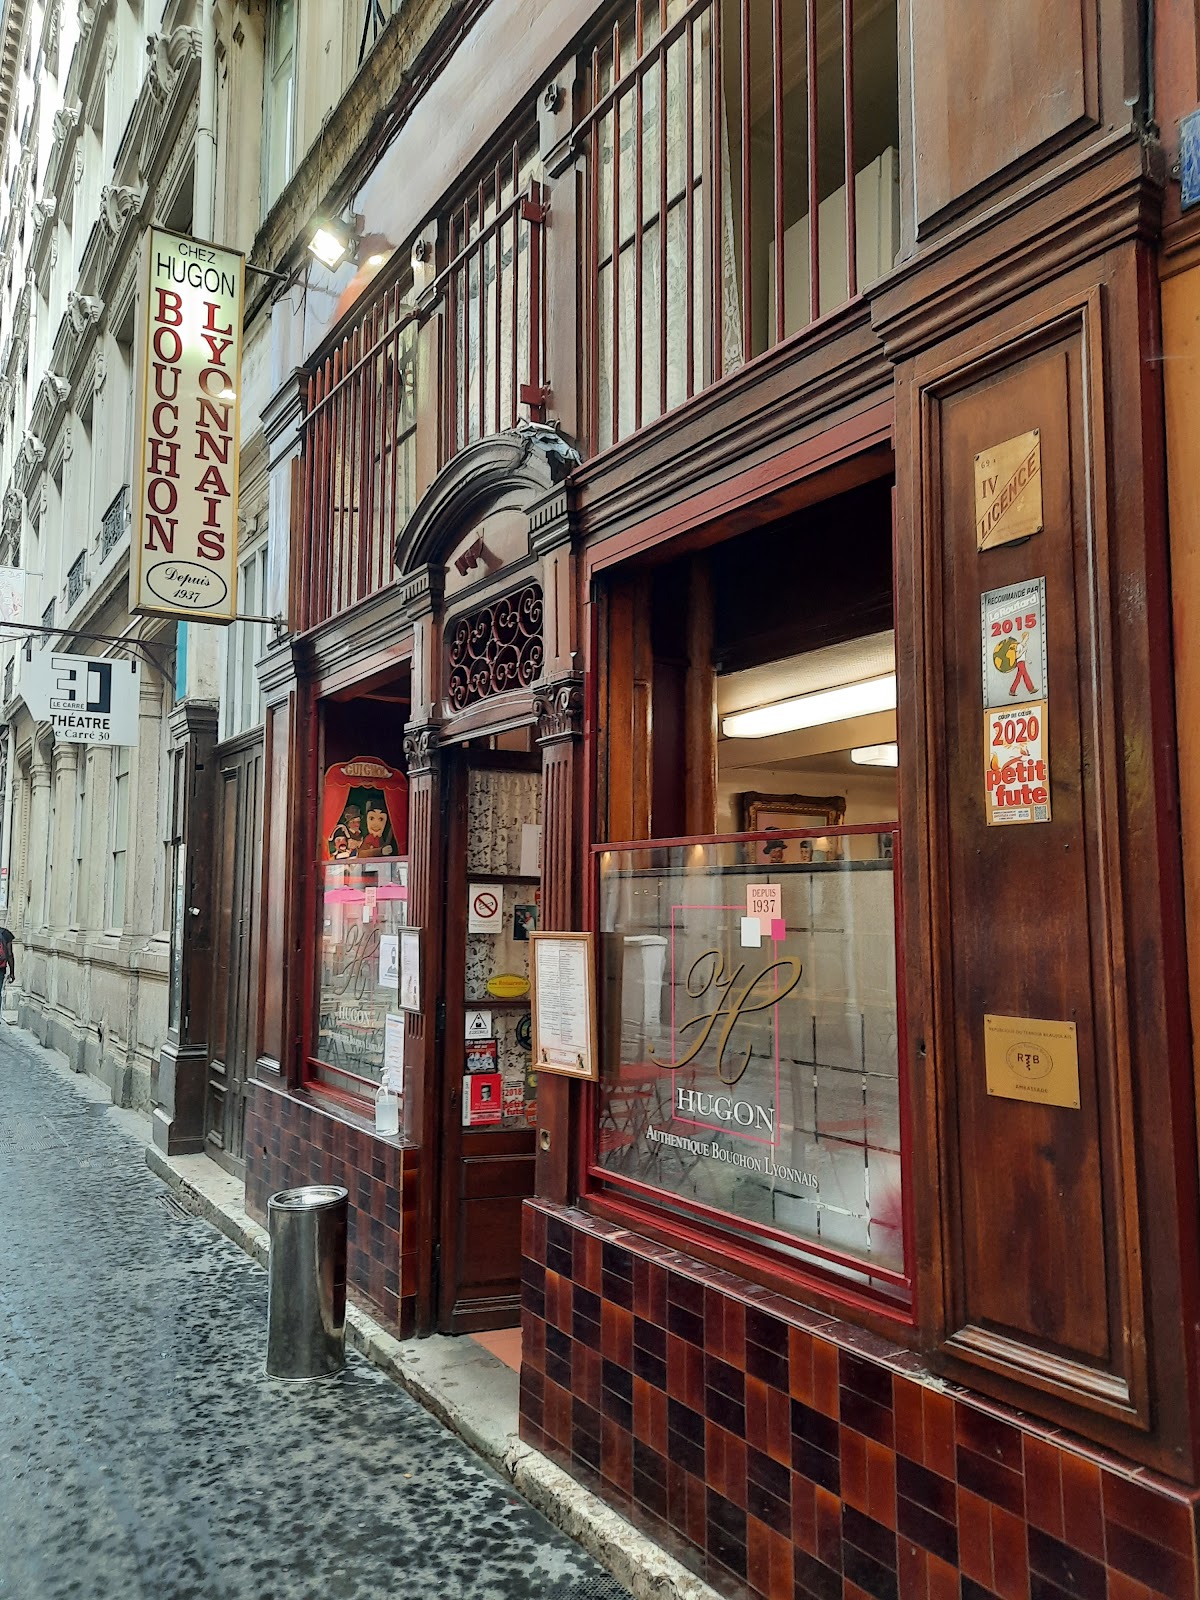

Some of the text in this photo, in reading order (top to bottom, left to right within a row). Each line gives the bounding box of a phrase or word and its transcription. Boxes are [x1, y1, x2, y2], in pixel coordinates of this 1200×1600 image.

[178, 242, 216, 265] CHEZ
[157, 252, 235, 298] HUGON
[145, 287, 183, 554] BOUCHON
[195, 301, 234, 561] LYONNAIS
[981, 474, 999, 499] IV
[981, 451, 1036, 540] LICENCE
[164, 566, 211, 588] Depuis
[172, 588, 201, 604] 1937
[1026, 585, 1039, 597] PAR
[989, 594, 1037, 620] Le Routard
[991, 613, 1037, 637] 2015
[998, 712, 1010, 721] COUP
[64, 729, 95, 740] Carré
[98, 731, 110, 741] 30
[992, 715, 1040, 747] 2020
[986, 758, 1047, 791] petit
[752, 888, 776, 898] DEPUIS
[752, 899, 776, 913] 1937
[339, 1005, 371, 1028] HUGON
[504, 1087, 523, 1097] 2018
[677, 1087, 776, 1133] HUGON
